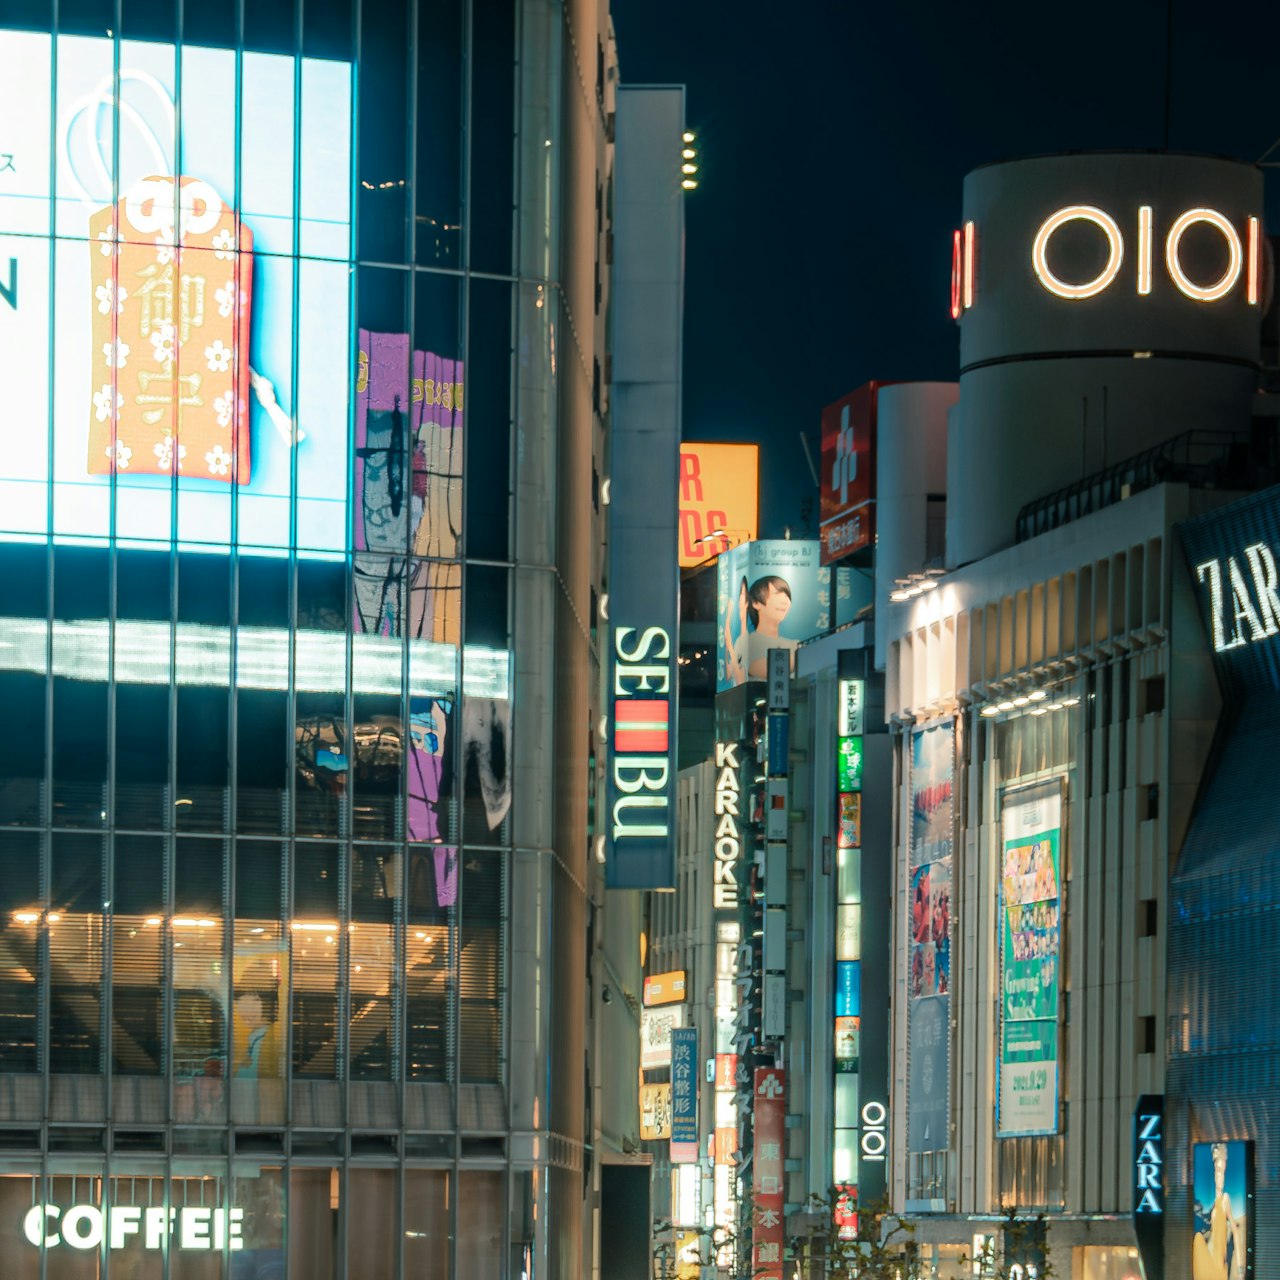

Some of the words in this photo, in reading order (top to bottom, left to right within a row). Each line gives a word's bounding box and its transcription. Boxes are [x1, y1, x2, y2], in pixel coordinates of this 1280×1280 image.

[132, 260, 208, 438] 御守
[714, 742, 740, 909] KARAOKE
[841, 1061, 854, 1071] 3F
[1135, 1114, 1163, 1213] ZARA
[23, 1204, 246, 1250] COFFEE
